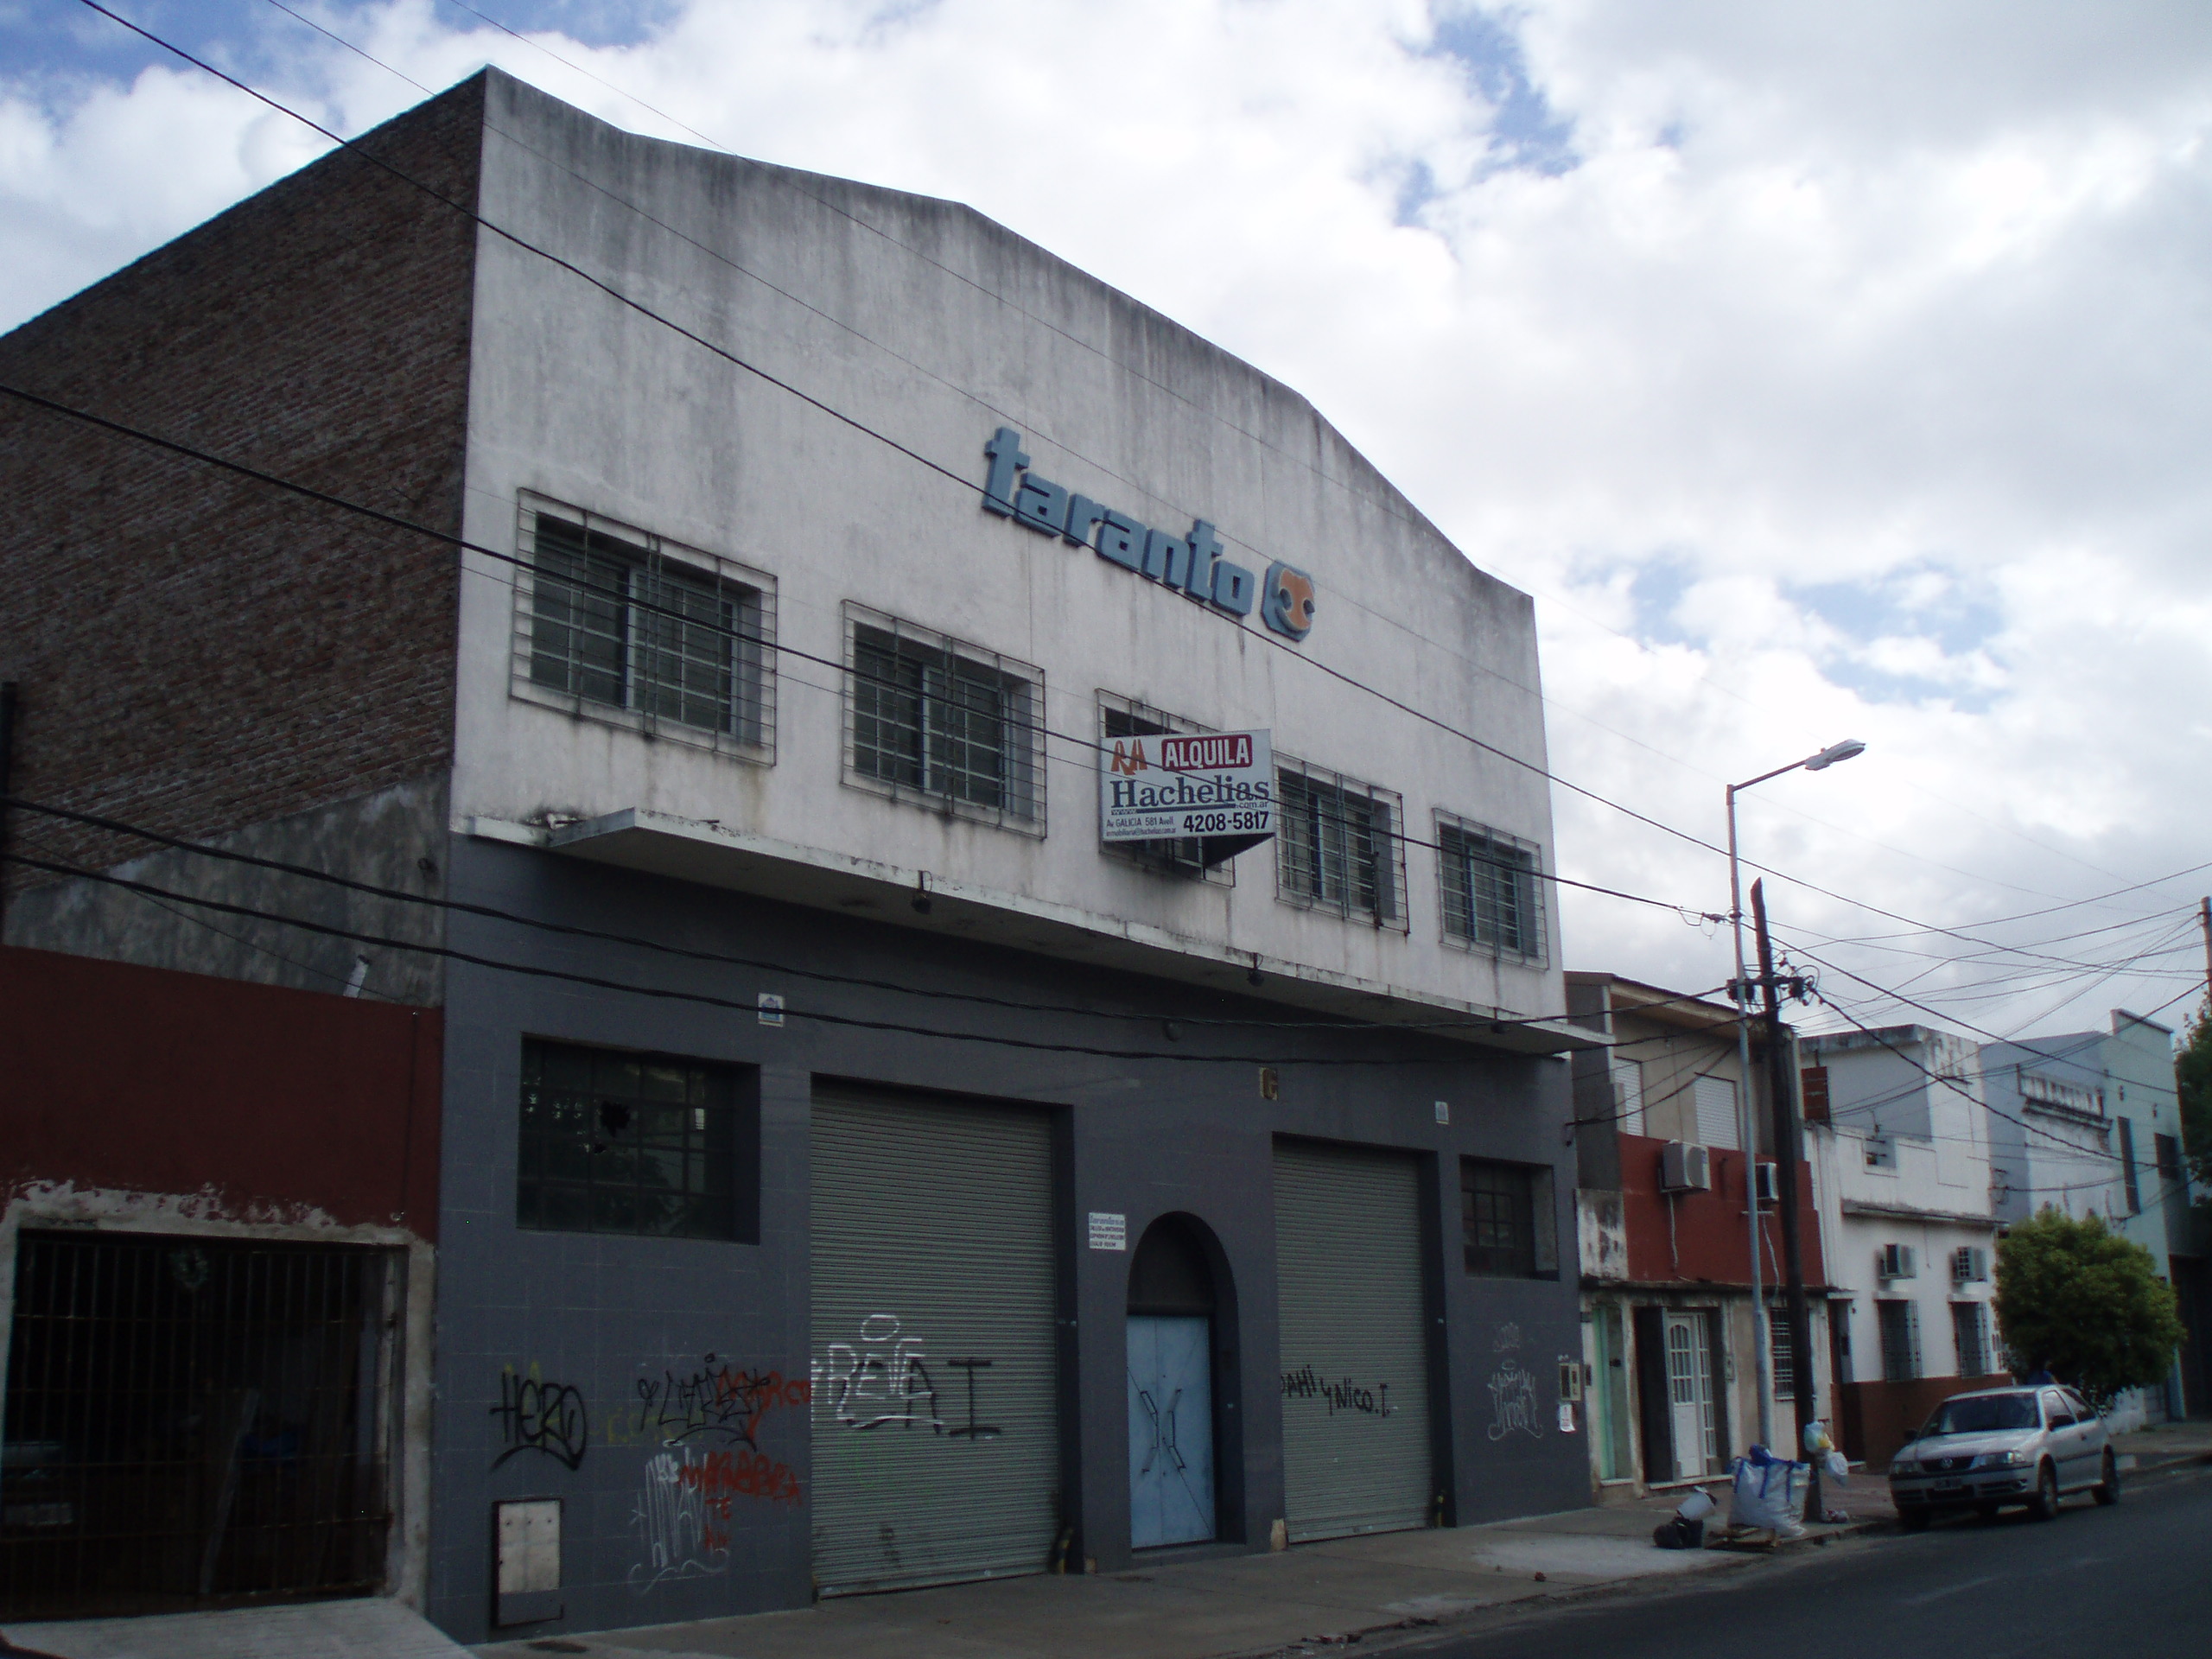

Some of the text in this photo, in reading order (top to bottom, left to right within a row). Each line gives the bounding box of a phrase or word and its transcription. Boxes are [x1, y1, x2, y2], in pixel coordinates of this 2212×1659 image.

[982, 427, 1255, 616] taranto
[1166, 738, 1249, 768] ALQUILA
[1110, 775, 1269, 808] Hachelias
[1116, 817, 1142, 827] GALICIA
[1145, 817, 1158, 826] 581
[1183, 810, 1269, 833] 4208-5817
